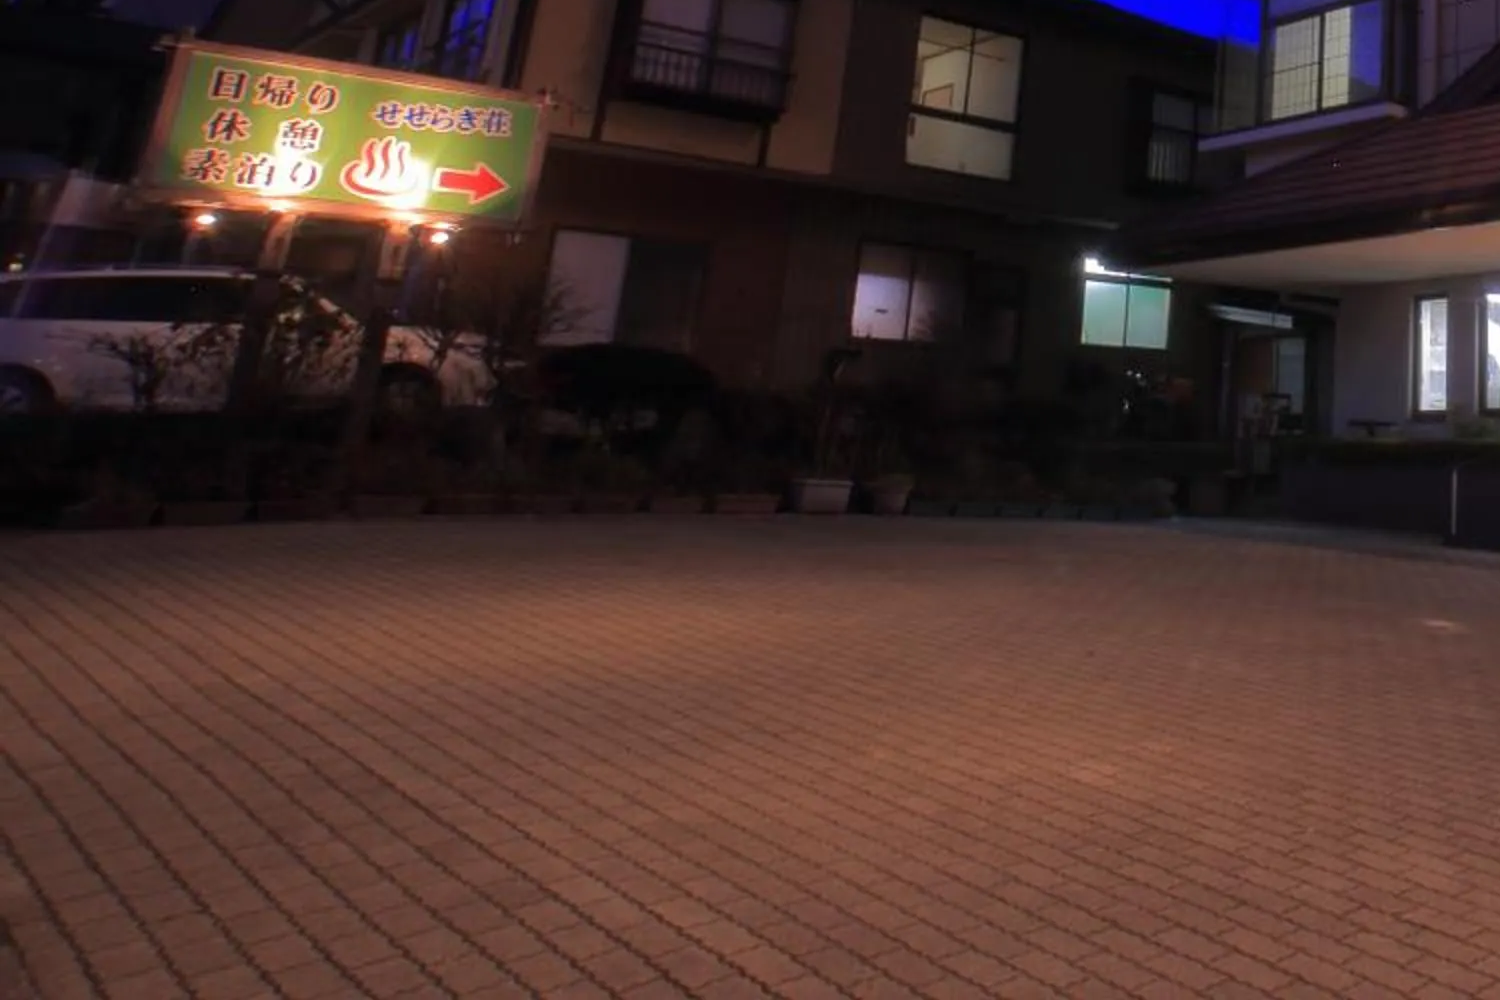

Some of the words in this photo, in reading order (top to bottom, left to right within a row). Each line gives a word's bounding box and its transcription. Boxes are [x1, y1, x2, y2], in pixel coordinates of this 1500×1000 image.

[212, 69, 337, 111] 日帰り
[207, 110, 320, 150] 休憩
[375, 103, 511, 135] せせらぎ荘
[185, 150, 318, 189] 素泊り
